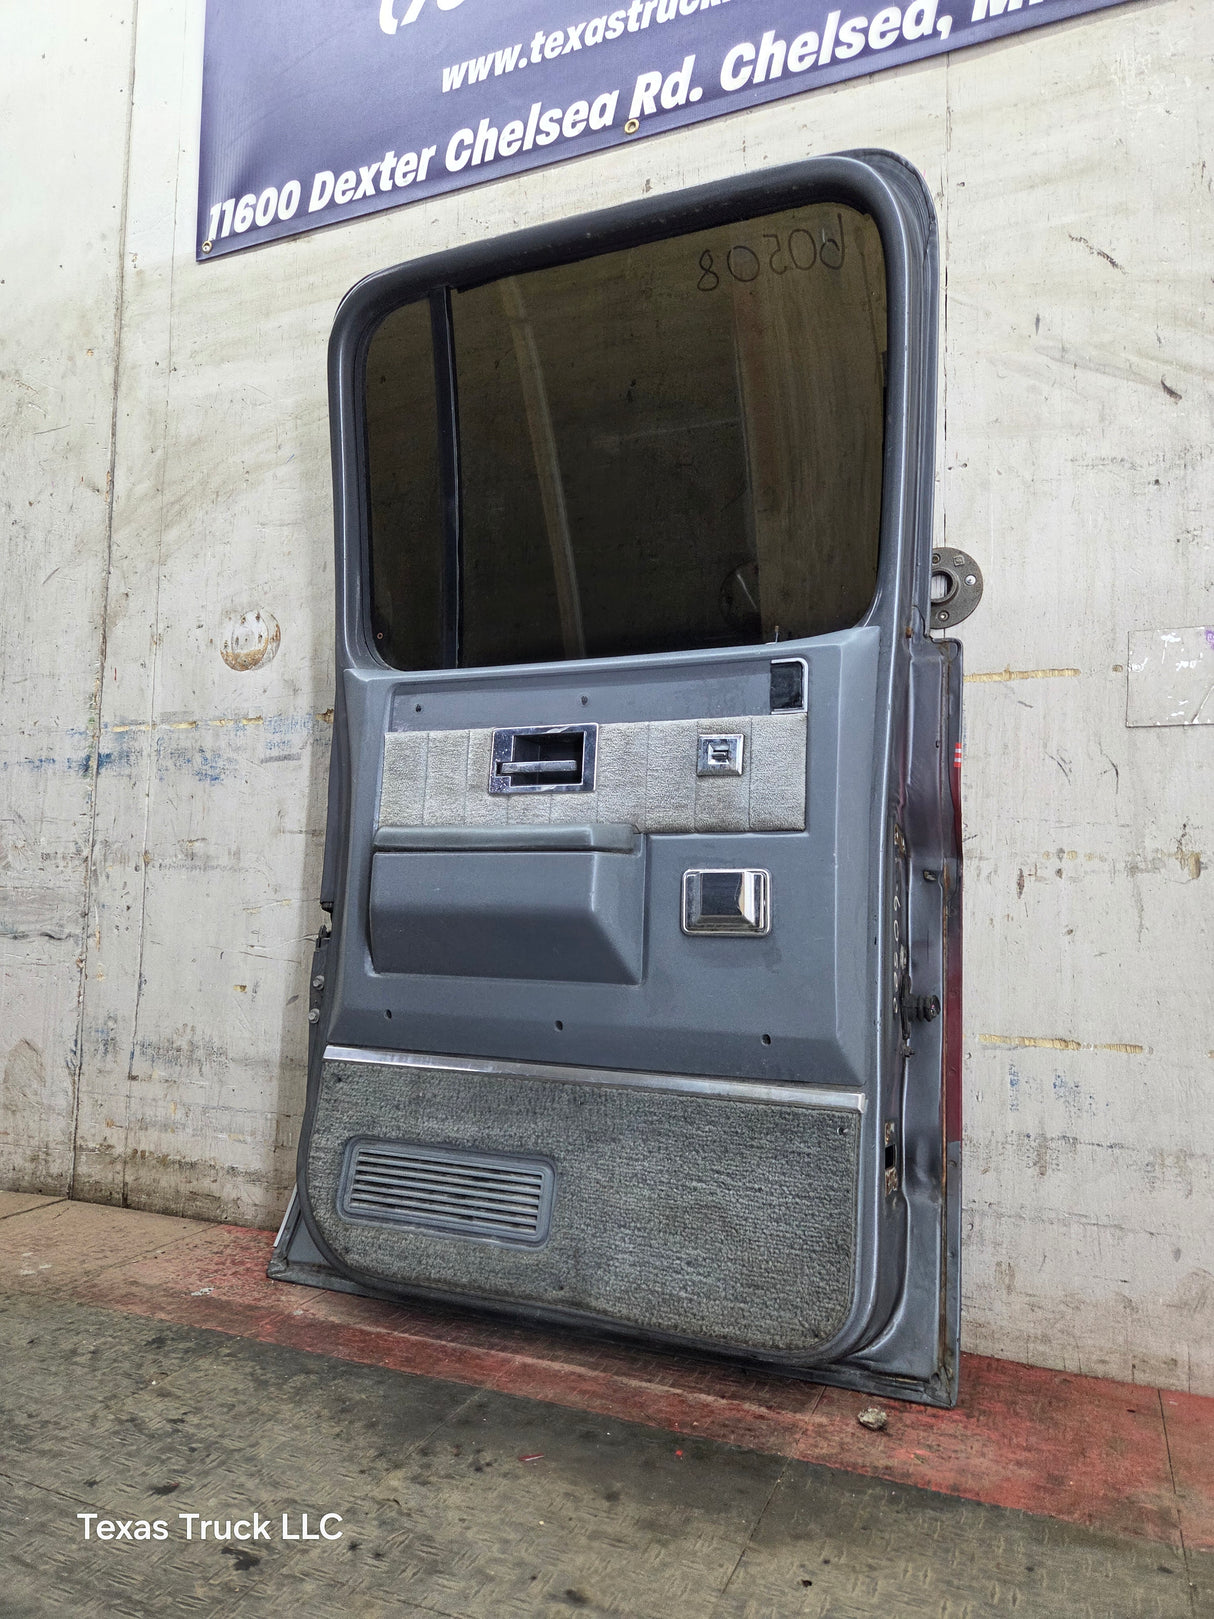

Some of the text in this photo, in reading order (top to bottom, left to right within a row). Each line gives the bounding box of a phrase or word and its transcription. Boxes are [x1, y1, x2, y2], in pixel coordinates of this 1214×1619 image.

[205, 0, 953, 244] 11600 Dexter Chelsea Rd. Chelsea,
[443, 0, 730, 93] www.texastru
